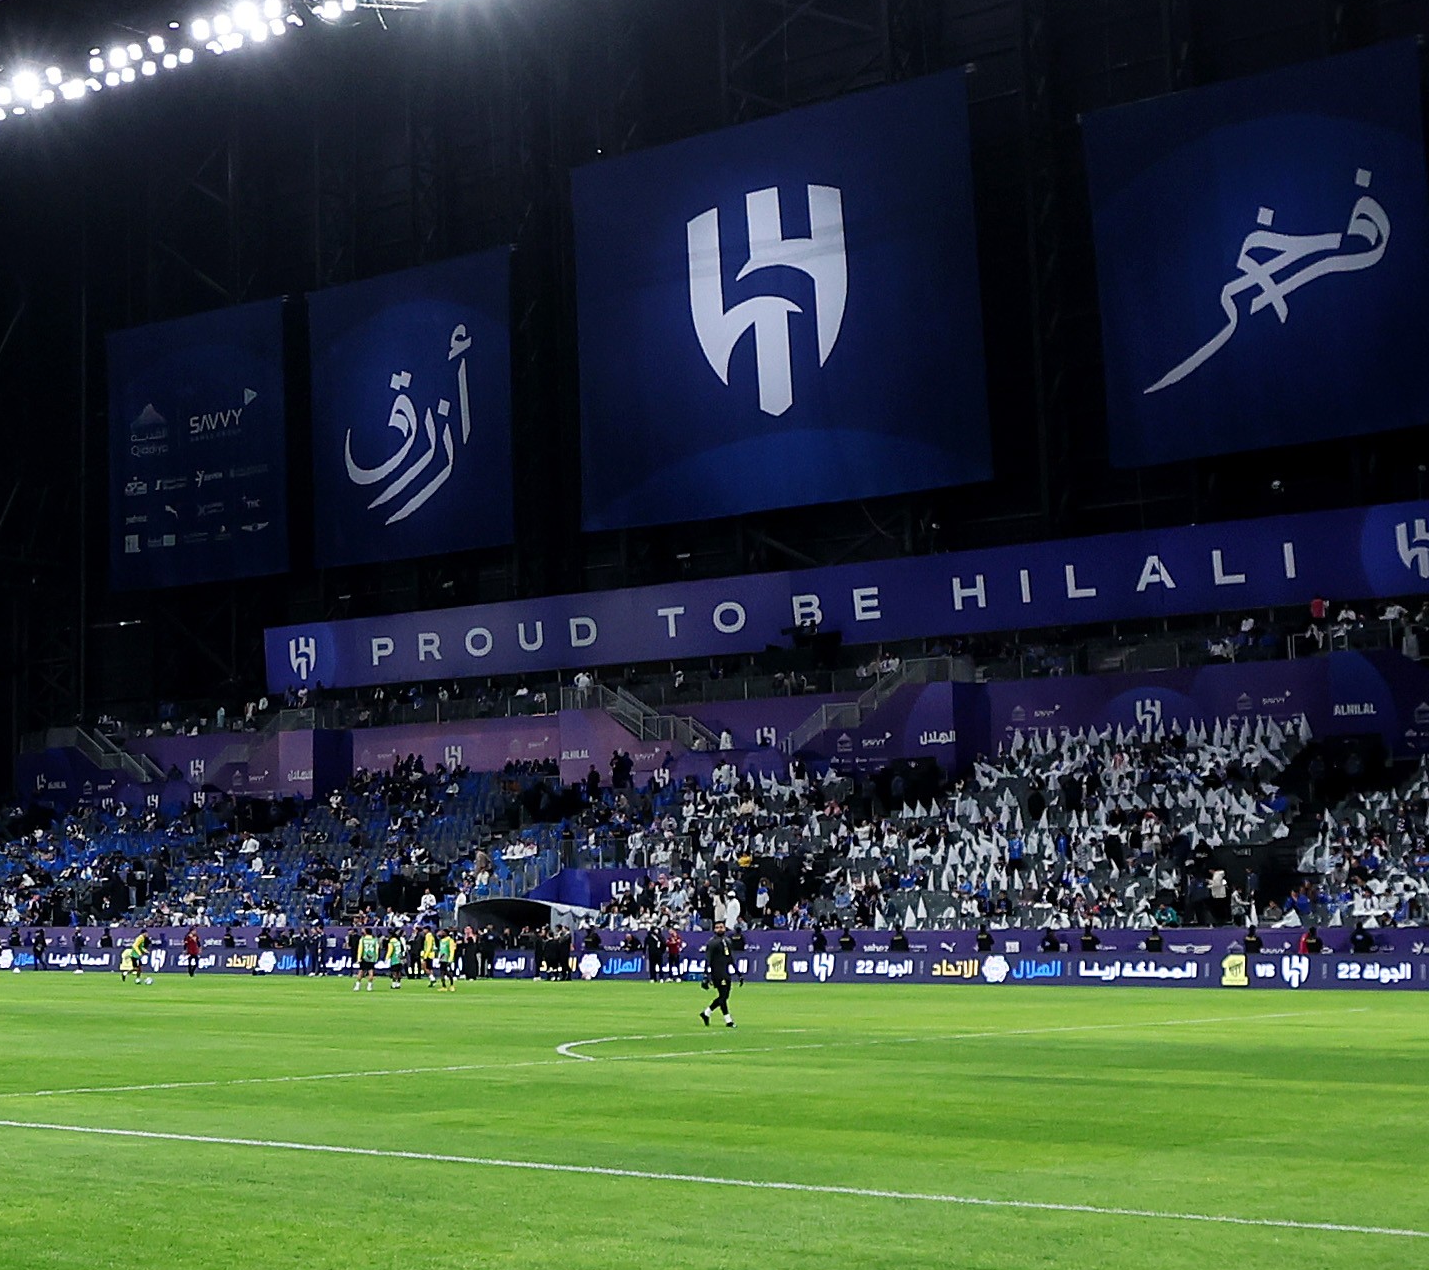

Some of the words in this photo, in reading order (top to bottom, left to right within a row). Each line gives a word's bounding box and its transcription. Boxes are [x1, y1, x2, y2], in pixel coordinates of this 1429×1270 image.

[1143, 167, 1391, 395] فخر
[189, 408, 243, 435] SAVVY
[344, 324, 472, 526] أزرق
[371, 615, 598, 667] PROUD
[656, 601, 747, 639] TO
[791, 586, 882, 628] BE
[952, 541, 1297, 612] HILALI
[855, 959, 874, 975] 22
[875, 959, 913, 978] الجولة
[931, 958, 979, 978] الاتحاد
[1011, 959, 1062, 979] الهلال
[1121, 961, 1198, 979] المملكة
[1337, 962, 1361, 979] 22
[1362, 962, 1412, 984] الجولة
